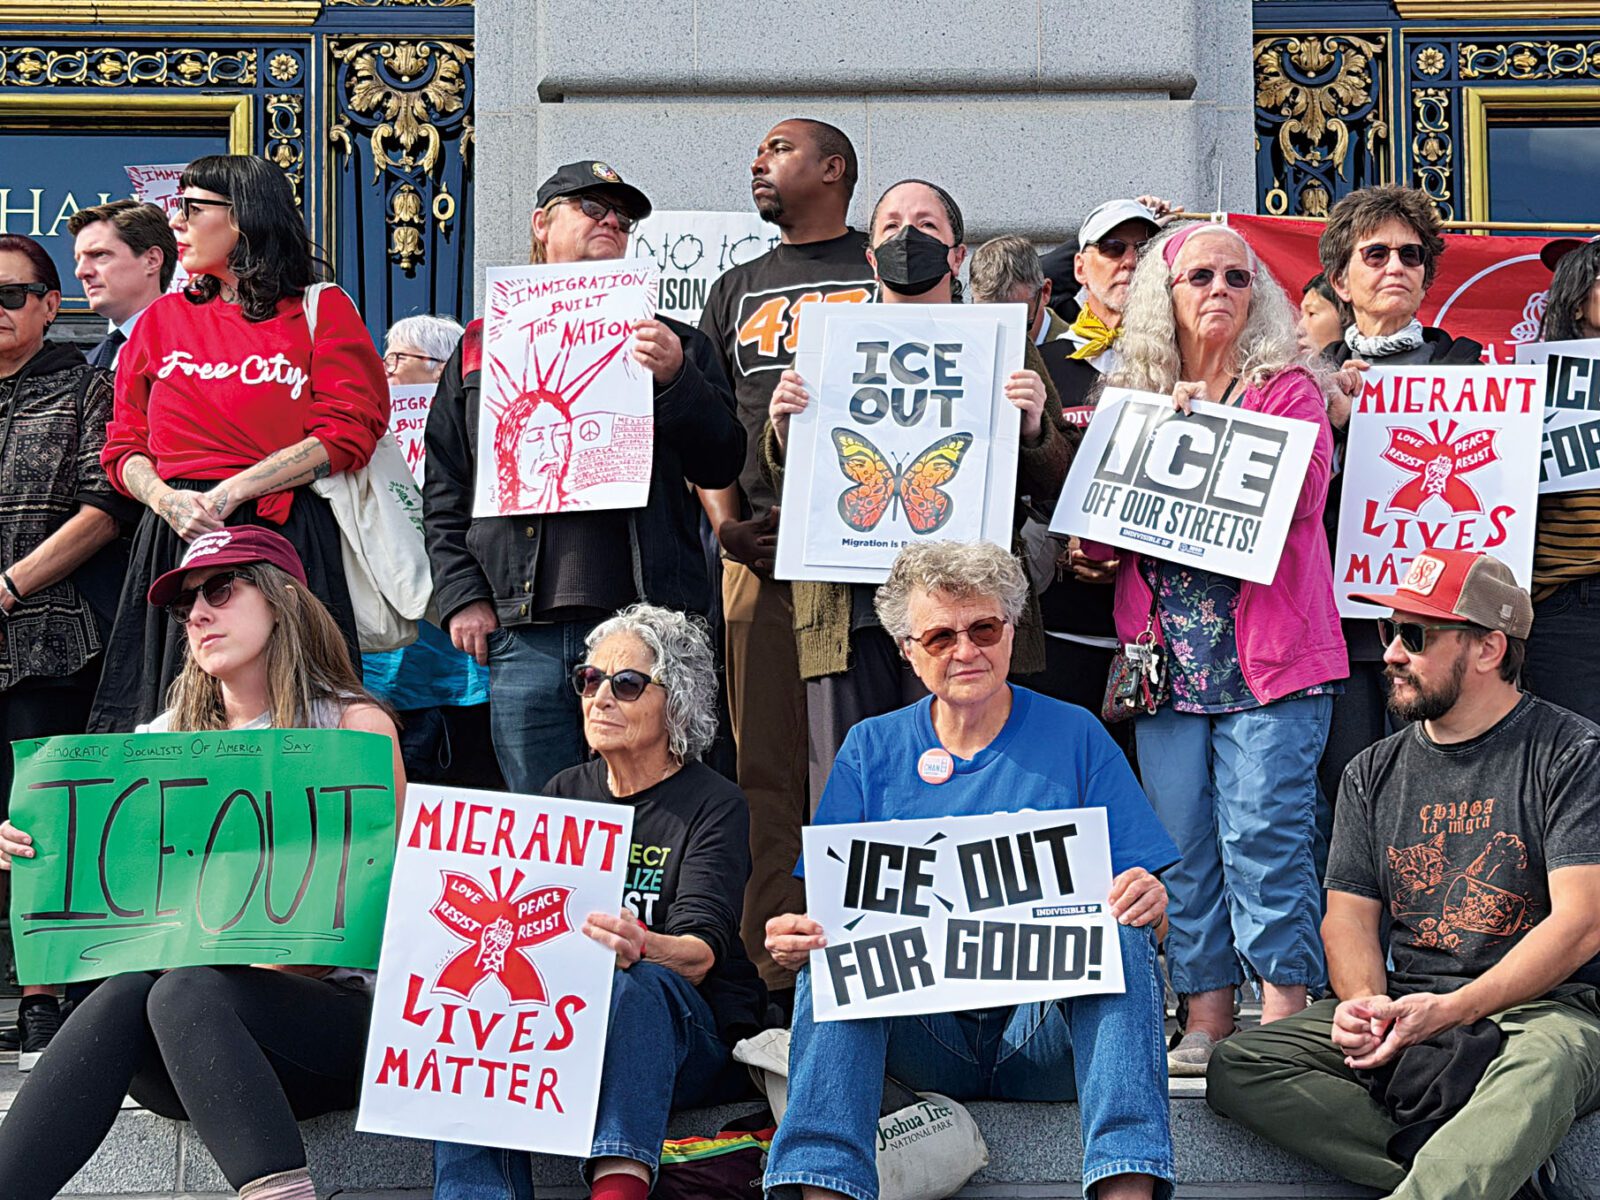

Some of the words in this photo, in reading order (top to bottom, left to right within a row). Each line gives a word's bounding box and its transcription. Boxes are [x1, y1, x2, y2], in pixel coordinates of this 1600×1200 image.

[0, 188, 140, 236] HA
[510, 272, 649, 307] IMMIGRATION
[547, 293, 609, 317] BUILT
[518, 318, 558, 345] THIS
[560, 317, 637, 350] NATION
[157, 350, 239, 379] Free
[240, 352, 309, 400] City
[851, 341, 964, 387] ICE
[849, 387, 964, 428] OUT
[1357, 375, 1537, 415] MIGRANT
[1396, 431, 1424, 448] LOVE
[1454, 431, 1490, 455] PEACE
[1097, 406, 1286, 512] ICE
[1387, 447, 1426, 468] RESIST
[1455, 446, 1491, 470] RESIST
[1082, 481, 1123, 518] OFF
[1120, 489, 1168, 531] OUR
[1165, 501, 1262, 554] STREETS!
[1362, 498, 1516, 550] LIVES
[841, 538, 888, 548] Migration
[890, 540, 899, 548] is
[34, 741, 110, 759] DEMOCRATIC
[123, 739, 183, 757] SOCIALISTS
[216, 739, 263, 753] AMERICA
[407, 800, 624, 872] MIGRANT
[843, 838, 938, 918] ICE
[956, 823, 1078, 913] OUT
[450, 879, 484, 904] LOVE
[518, 890, 561, 919] PEACE
[438, 900, 482, 932] RESIST
[517, 911, 561, 941] RESIST
[1036, 906, 1086, 916] INDIVISIBLE
[824, 926, 936, 1007] FOR
[944, 918, 1104, 981] GOOD!
[402, 973, 588, 1055] LIVES
[375, 1046, 565, 1114] MATTER
[877, 1115, 925, 1152] Joshua
[889, 1127, 932, 1152] NATIONAL
[931, 1119, 954, 1134] PARK
